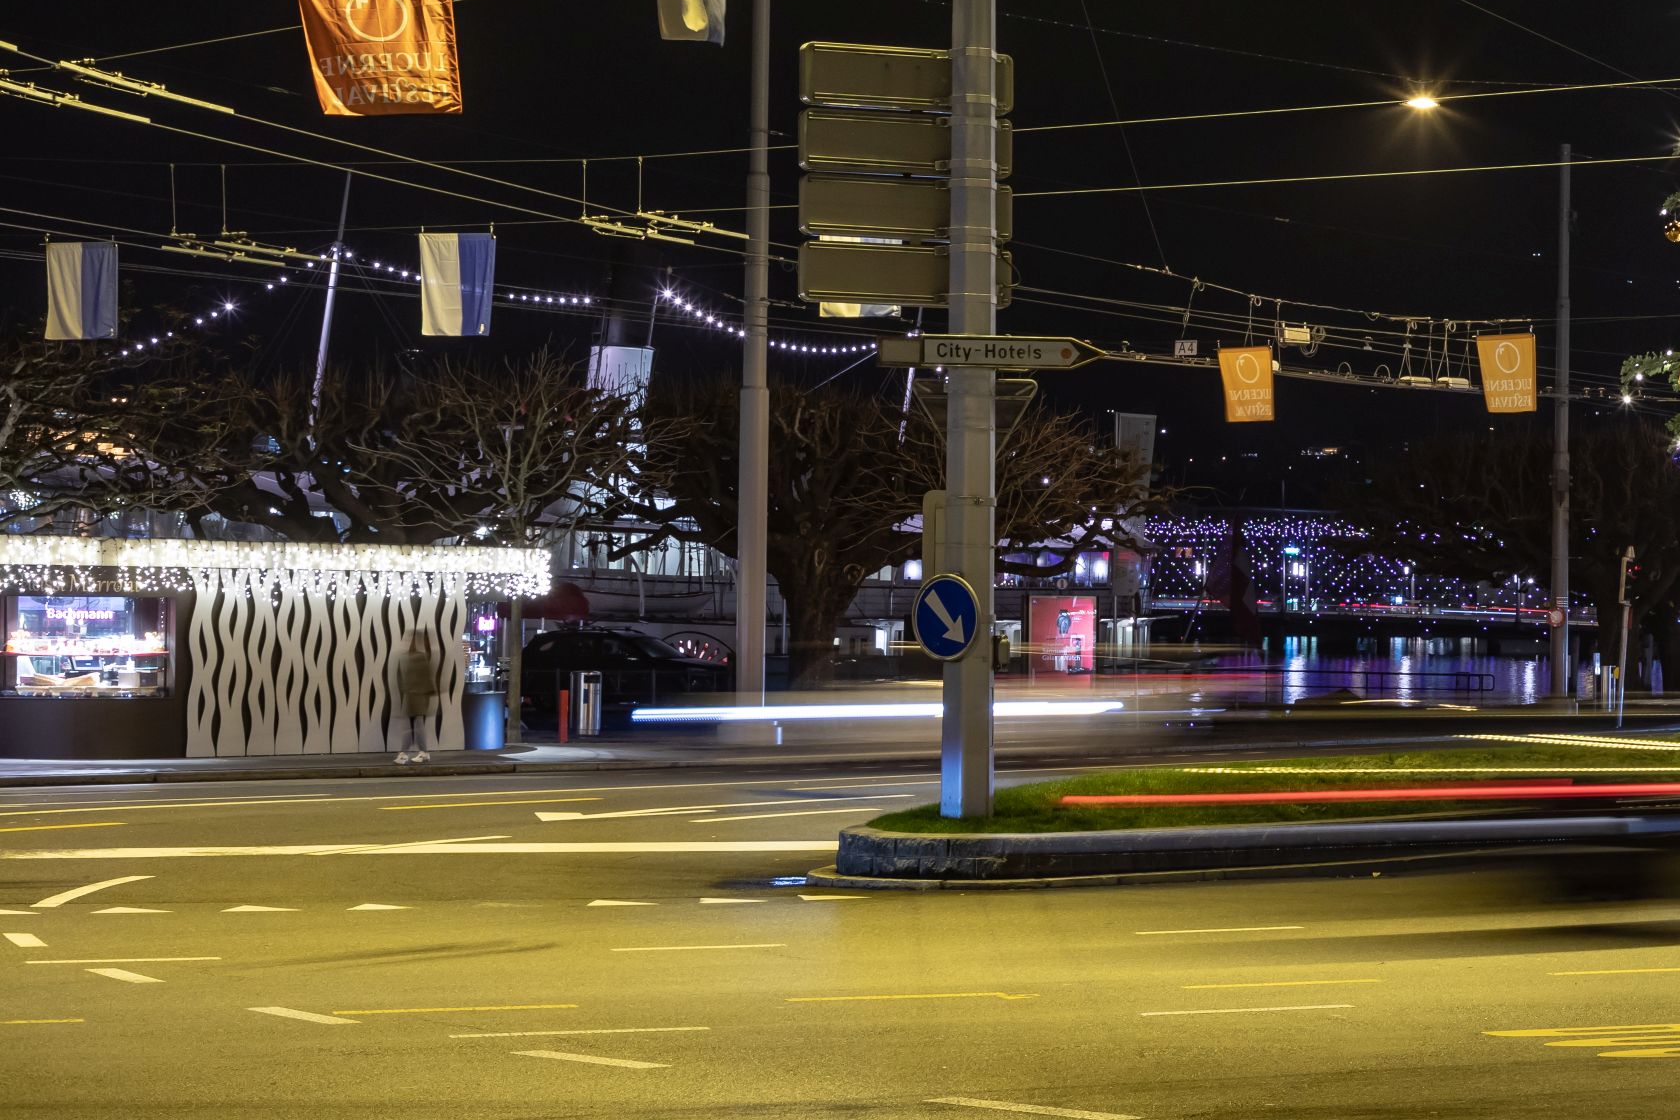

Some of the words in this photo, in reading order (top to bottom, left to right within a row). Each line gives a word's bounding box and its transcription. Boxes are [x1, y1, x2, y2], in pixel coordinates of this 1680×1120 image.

[936, 342, 1043, 362] City-Hotels
[1177, 341, 1194, 355] A4
[46, 607, 114, 620] Bachmann
